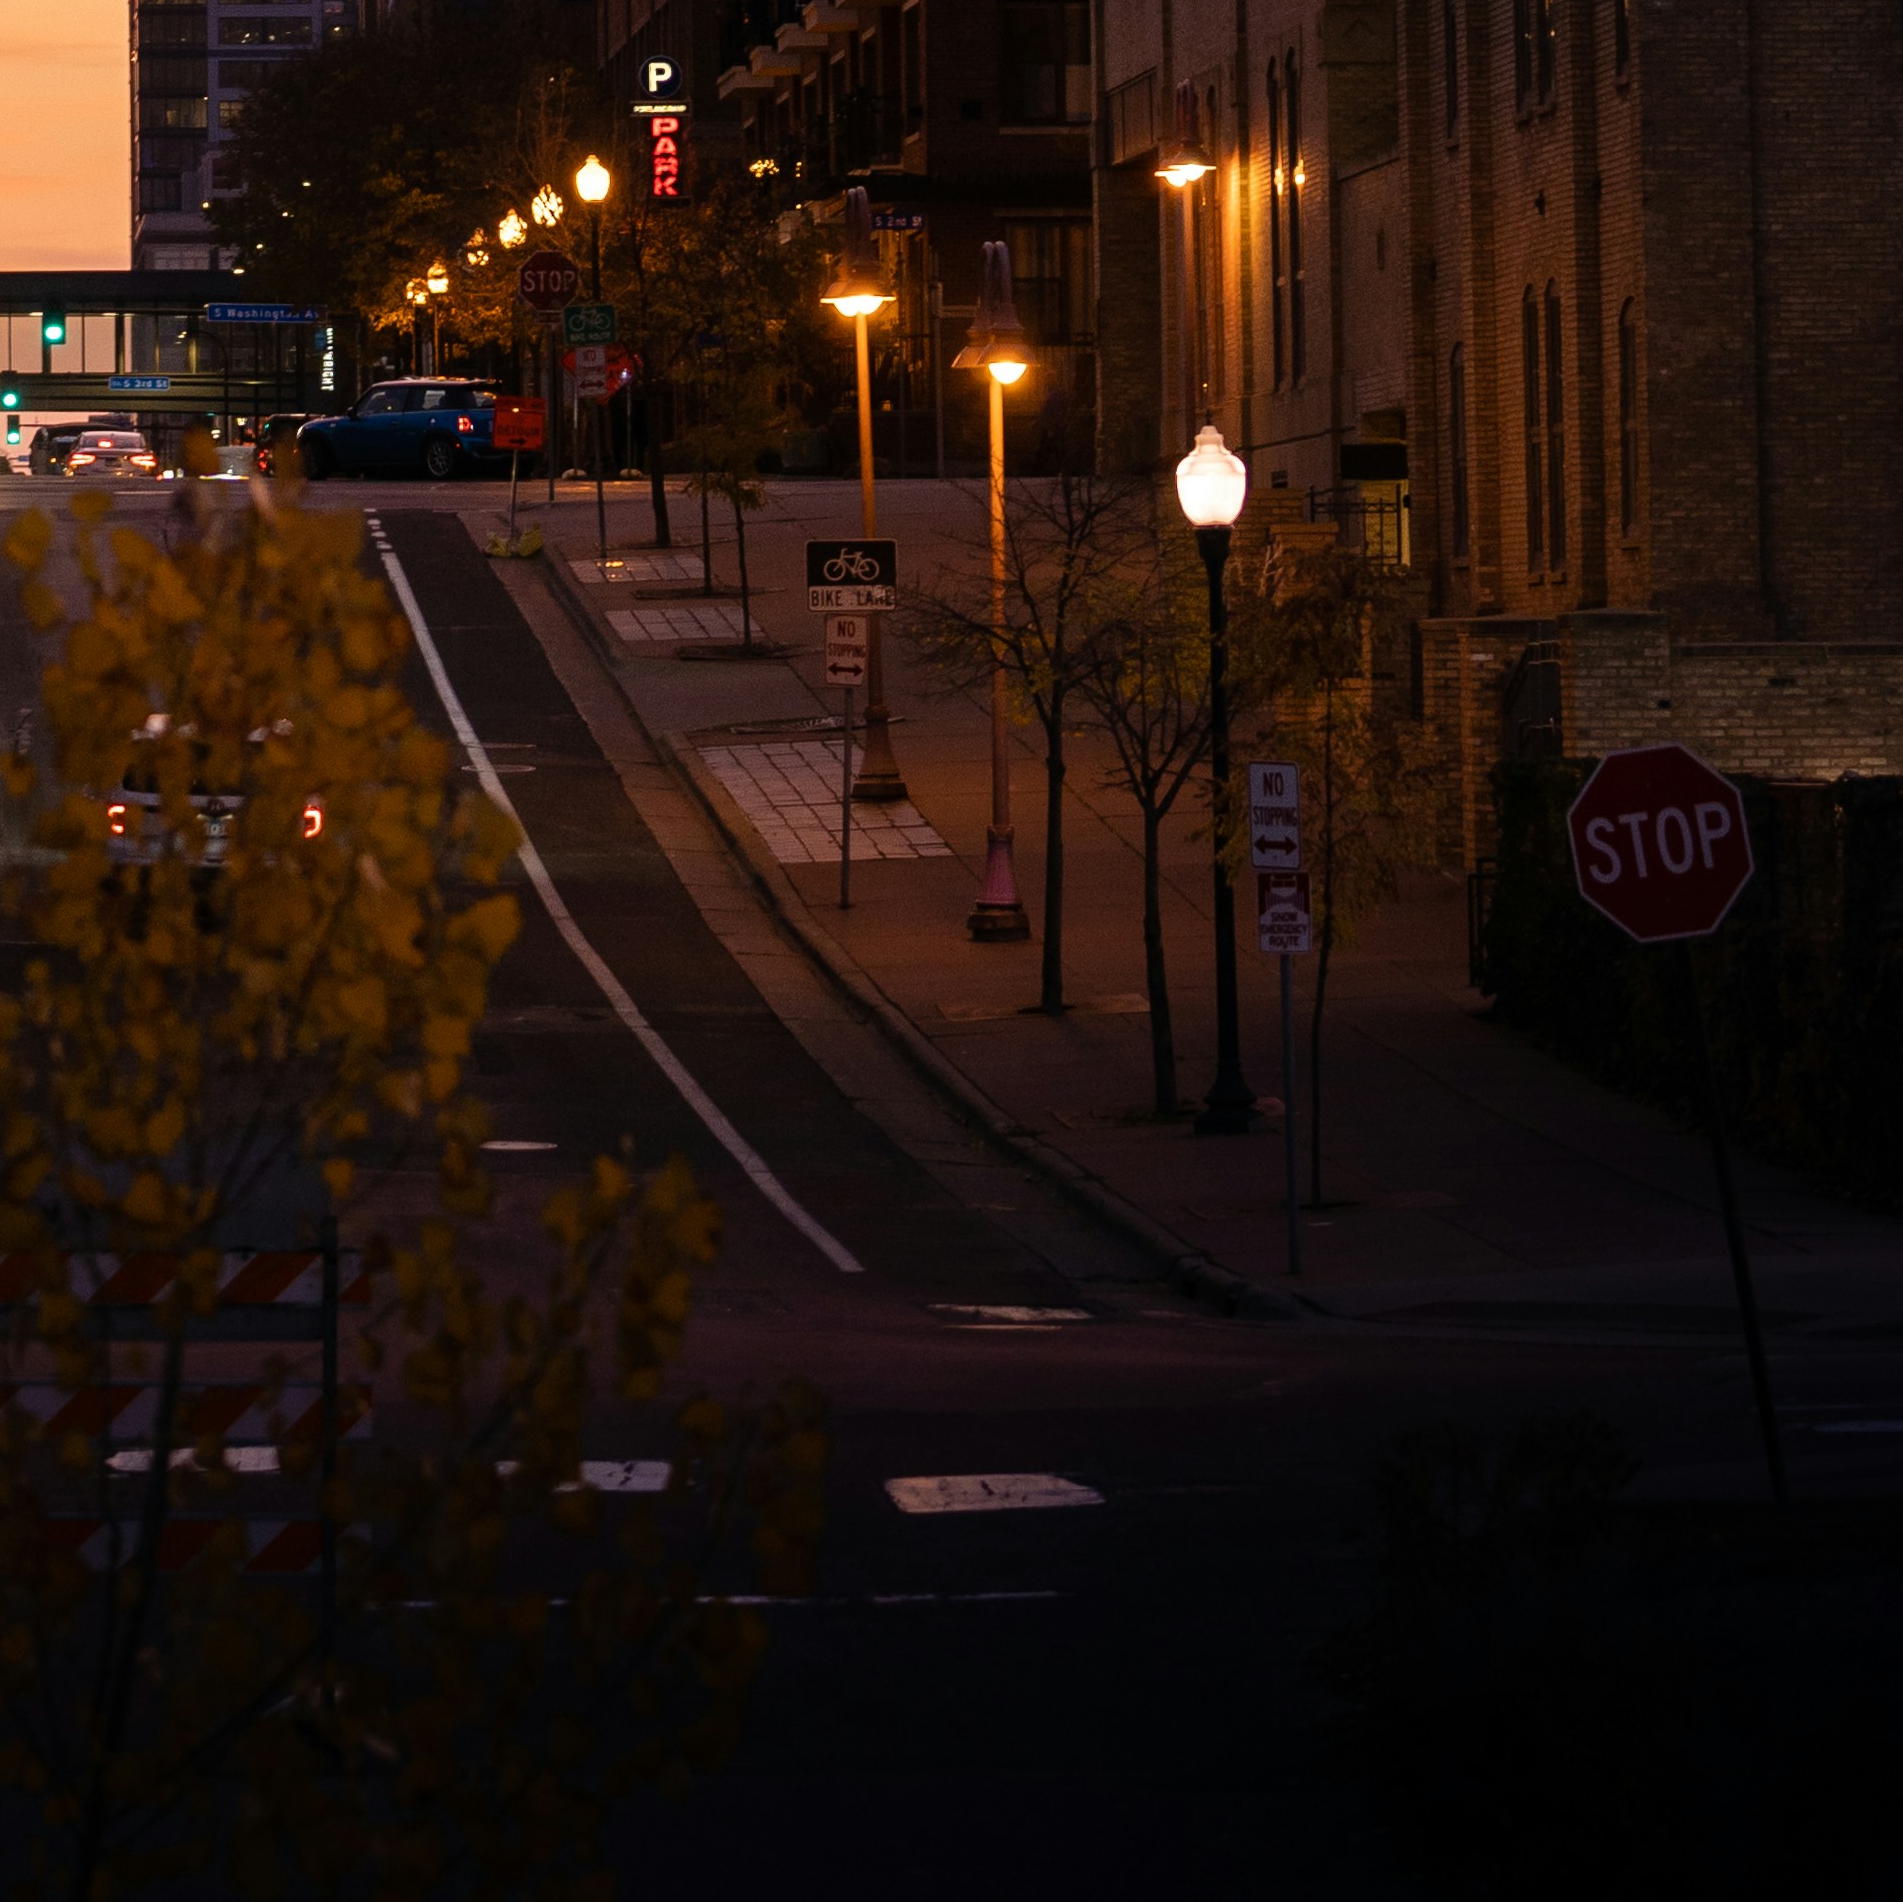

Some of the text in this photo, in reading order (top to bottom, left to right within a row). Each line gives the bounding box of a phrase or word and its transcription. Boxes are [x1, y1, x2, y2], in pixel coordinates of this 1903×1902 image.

[648, 62, 672, 92] P
[652, 117, 679, 196] PARK
[523, 270, 576, 292] STOP
[214, 307, 223, 318] S
[811, 589, 843, 607] BIKE
[837, 620, 856, 637] NO
[1263, 772, 1284, 796] NO
[1253, 805, 1298, 827] STOPPING
[1585, 800, 1732, 885] STOP
[1271, 911, 1298, 922] SNOW
[1260, 924, 1307, 935] EMERGENCY
[1269, 936, 1300, 947] ROUTE
